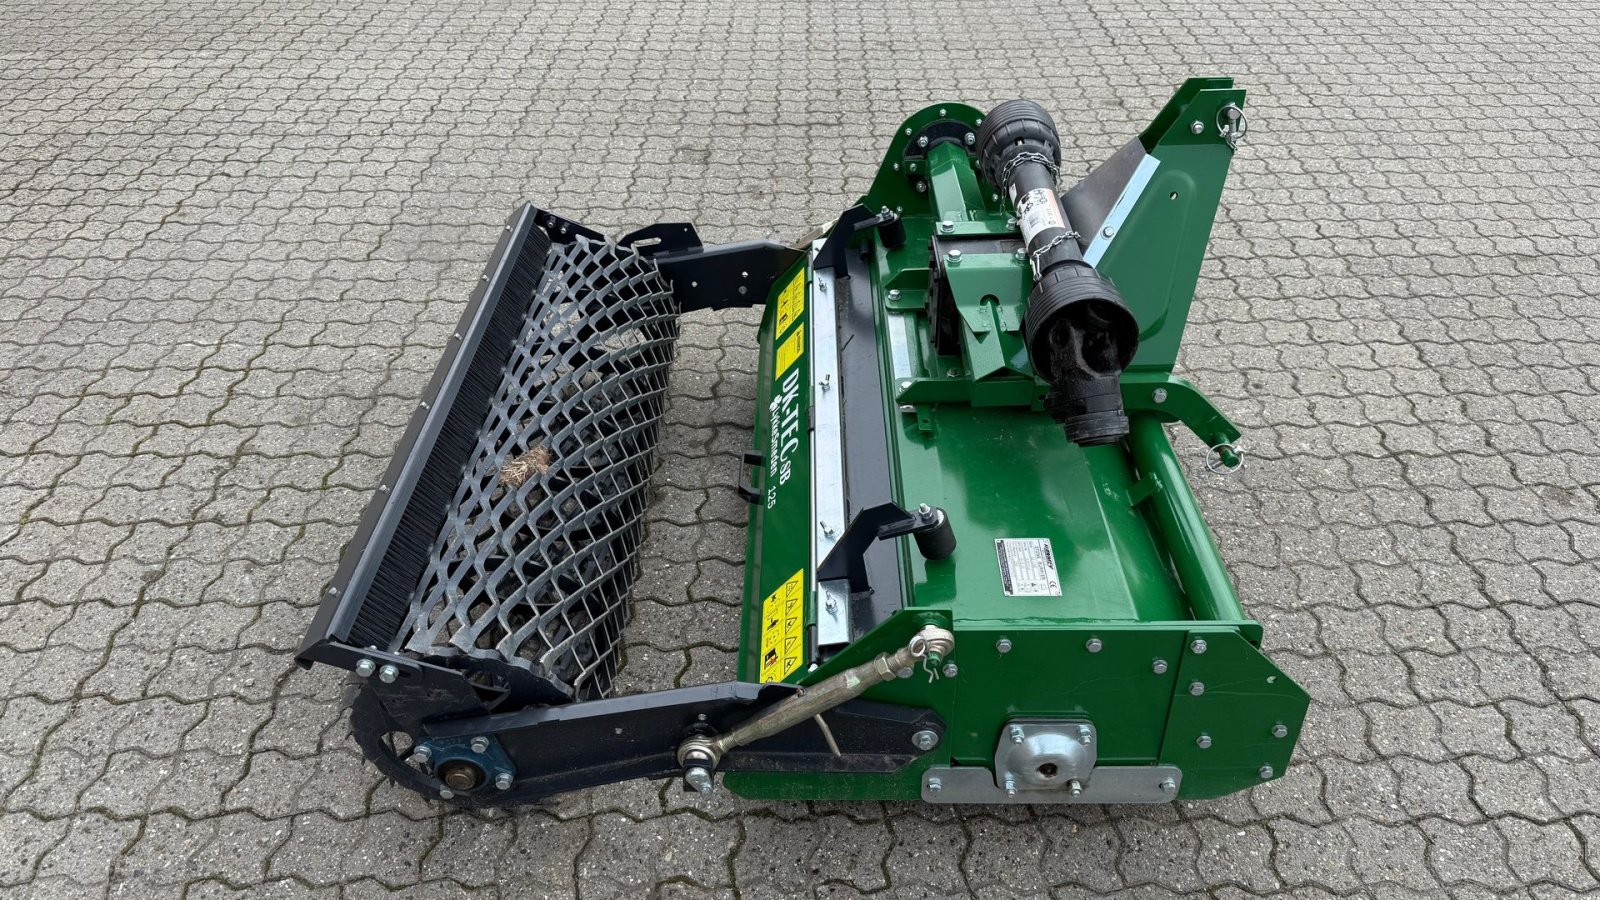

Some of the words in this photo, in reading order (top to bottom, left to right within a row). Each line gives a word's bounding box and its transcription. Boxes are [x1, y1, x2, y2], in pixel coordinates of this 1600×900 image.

[780, 368, 799, 462] DK-TEC
[770, 406, 780, 477] LykkeSmeden
[780, 460, 791, 485] SB
[767, 485, 777, 509] 125
